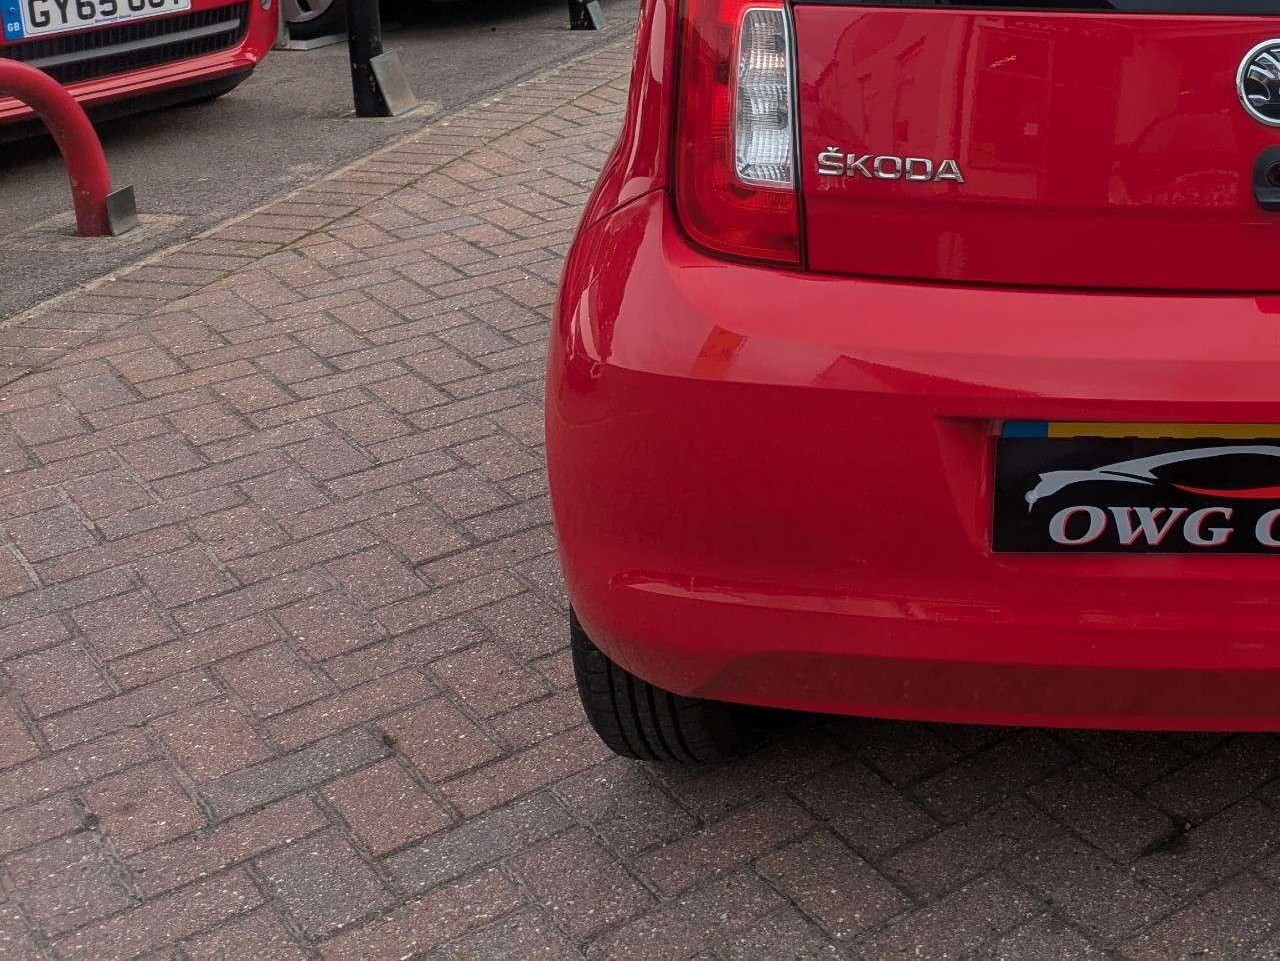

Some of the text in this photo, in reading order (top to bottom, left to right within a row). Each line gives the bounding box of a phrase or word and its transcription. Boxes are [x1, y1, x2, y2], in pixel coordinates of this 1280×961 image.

[7, 21, 20, 32] GB
[817, 146, 965, 183] ŠKODA
[1048, 505, 1234, 547] OWG
